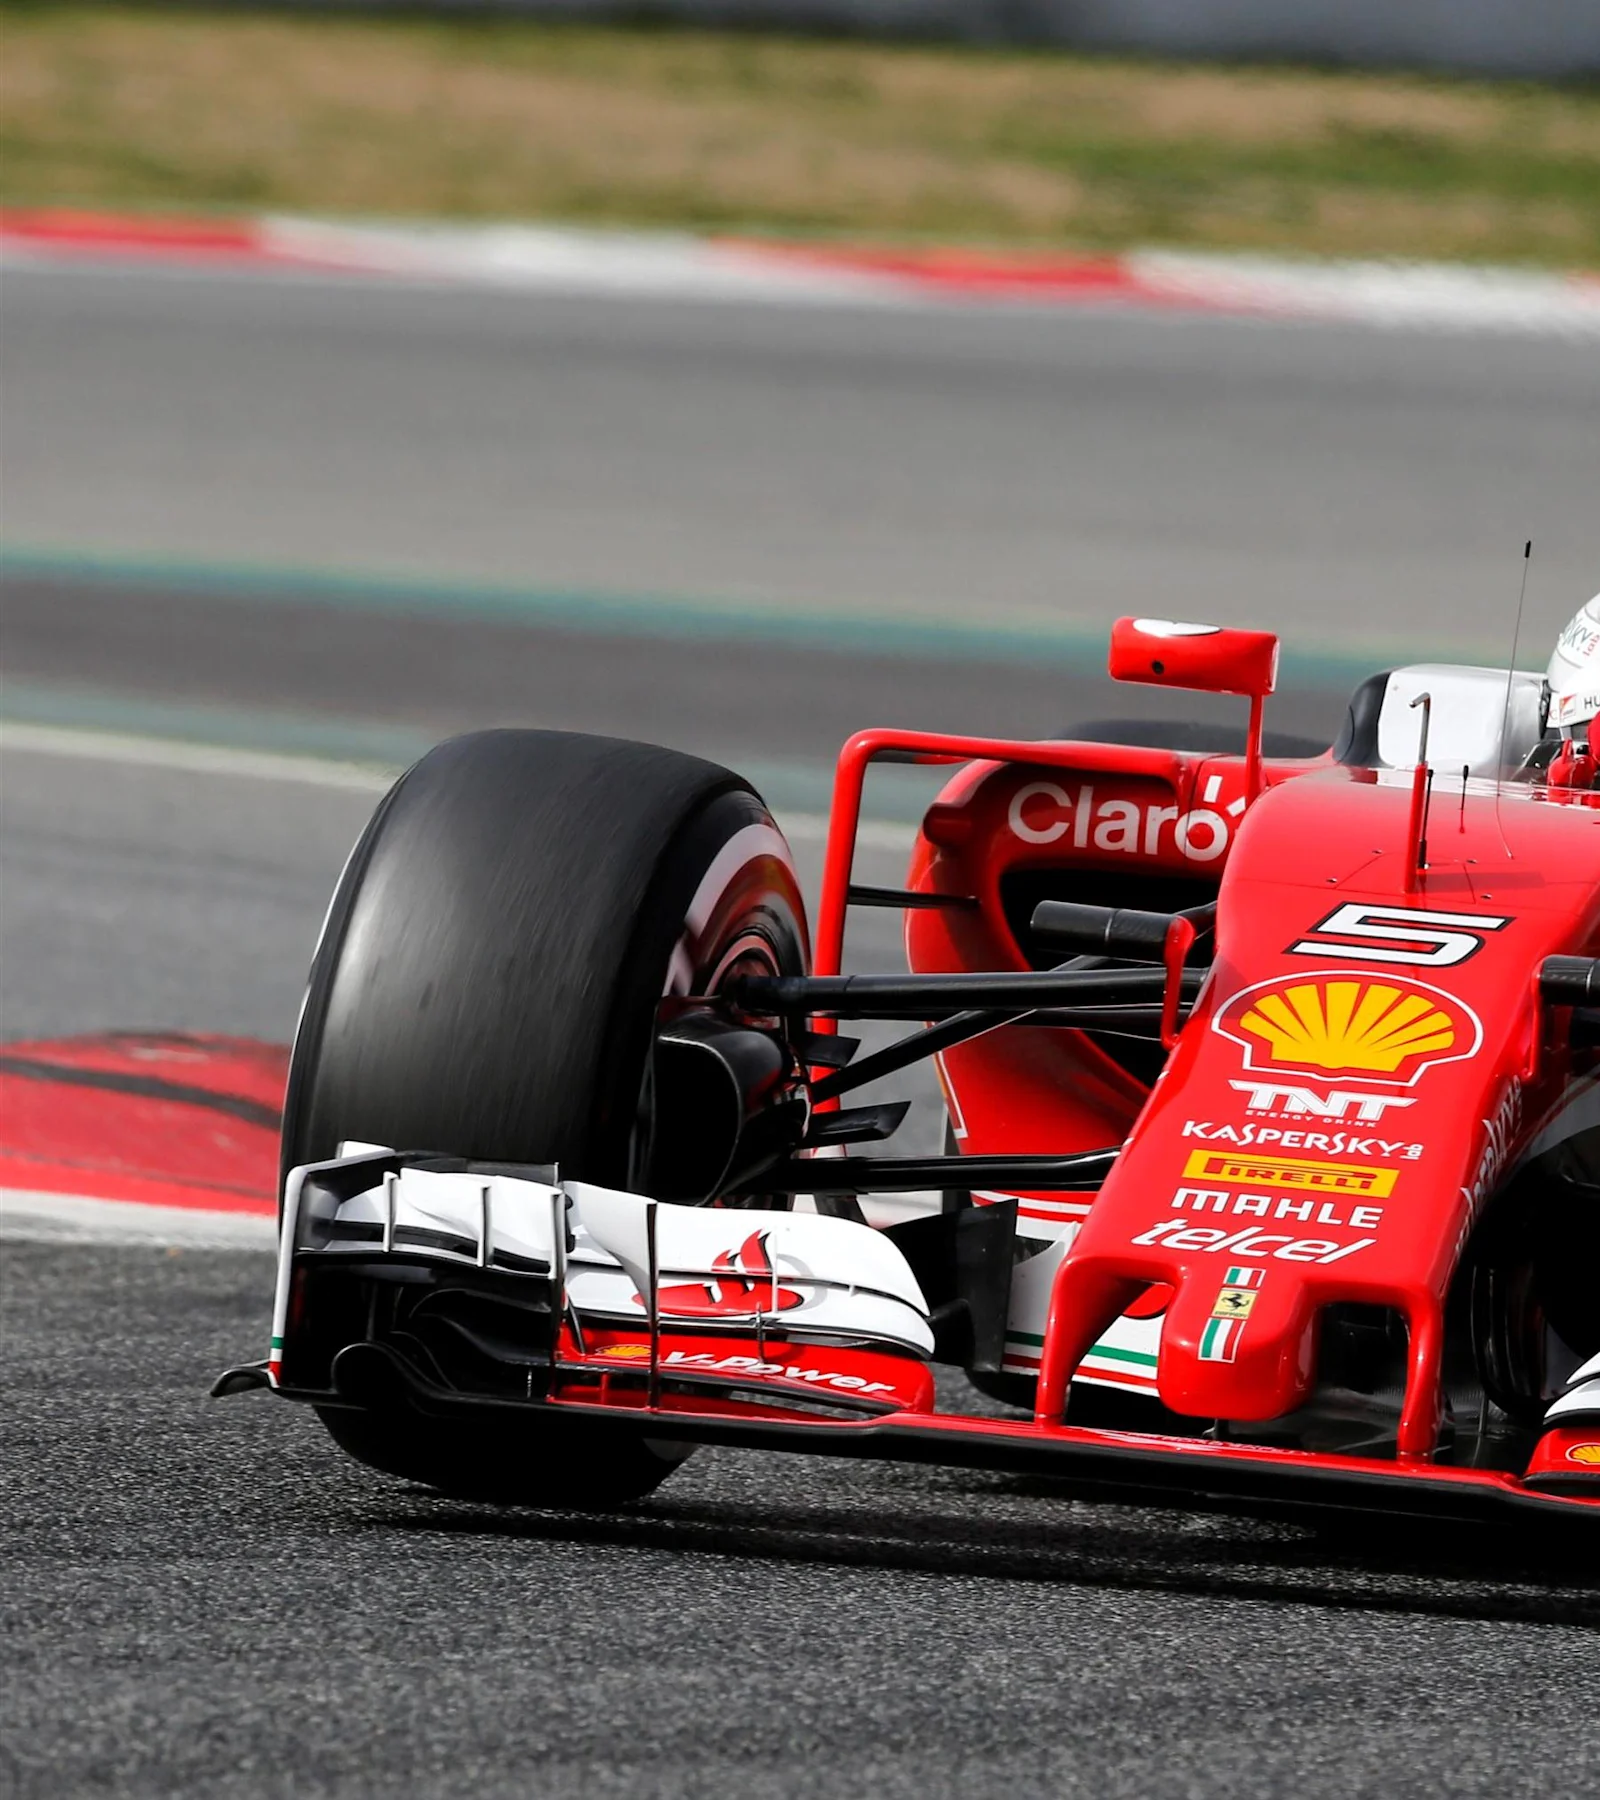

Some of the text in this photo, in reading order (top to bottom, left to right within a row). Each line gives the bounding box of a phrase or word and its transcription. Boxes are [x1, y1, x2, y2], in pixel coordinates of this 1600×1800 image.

[1282, 901, 1516, 967] 5
[1229, 1079, 1417, 1122] TNT
[1245, 1110, 1377, 1128] ENERGY DRINK
[1182, 1119, 1425, 1160] KASPERSKY lab
[1204, 1158, 1378, 1190] PIRELLI
[1171, 1188, 1384, 1229] MAHLE
[1131, 1217, 1377, 1264] telcel
[665, 1351, 897, 1394] V-Power
